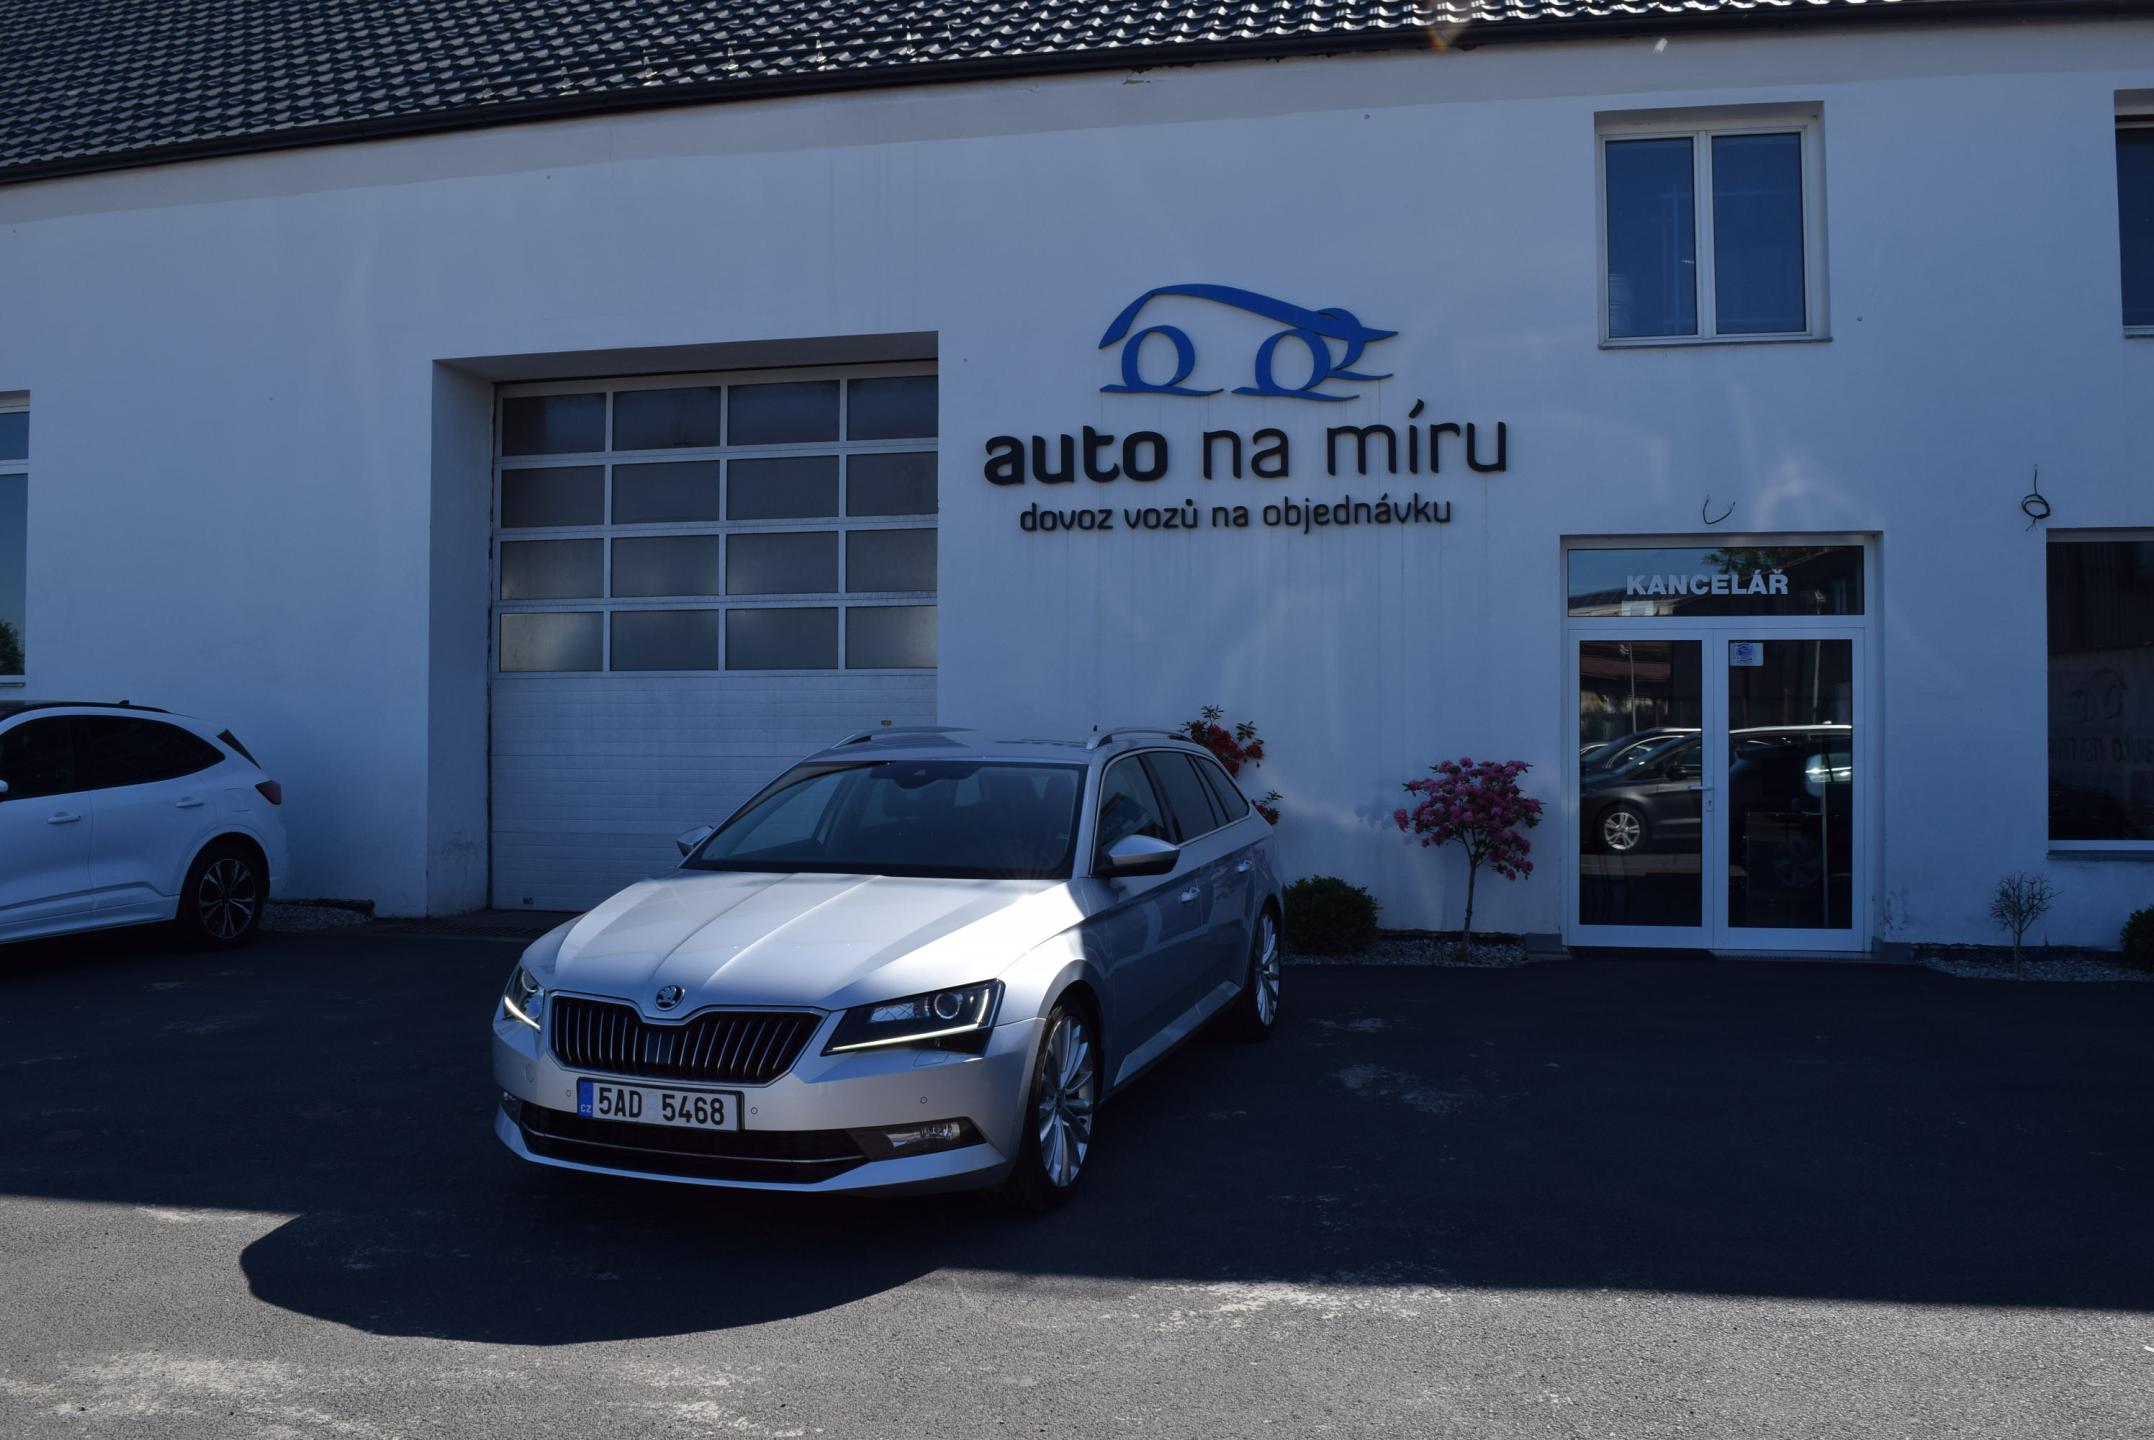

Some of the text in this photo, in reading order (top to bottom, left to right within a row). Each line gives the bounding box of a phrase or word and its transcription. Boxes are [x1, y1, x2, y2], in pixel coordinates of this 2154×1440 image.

[984, 399, 1507, 485] auto na míru
[1020, 492, 1452, 534] dovoz vozů na objednávku
[1627, 569, 1789, 595] KANCELÁŘ
[580, 1104, 592, 1113] CZ
[599, 1086, 725, 1126] 5AD 5468
